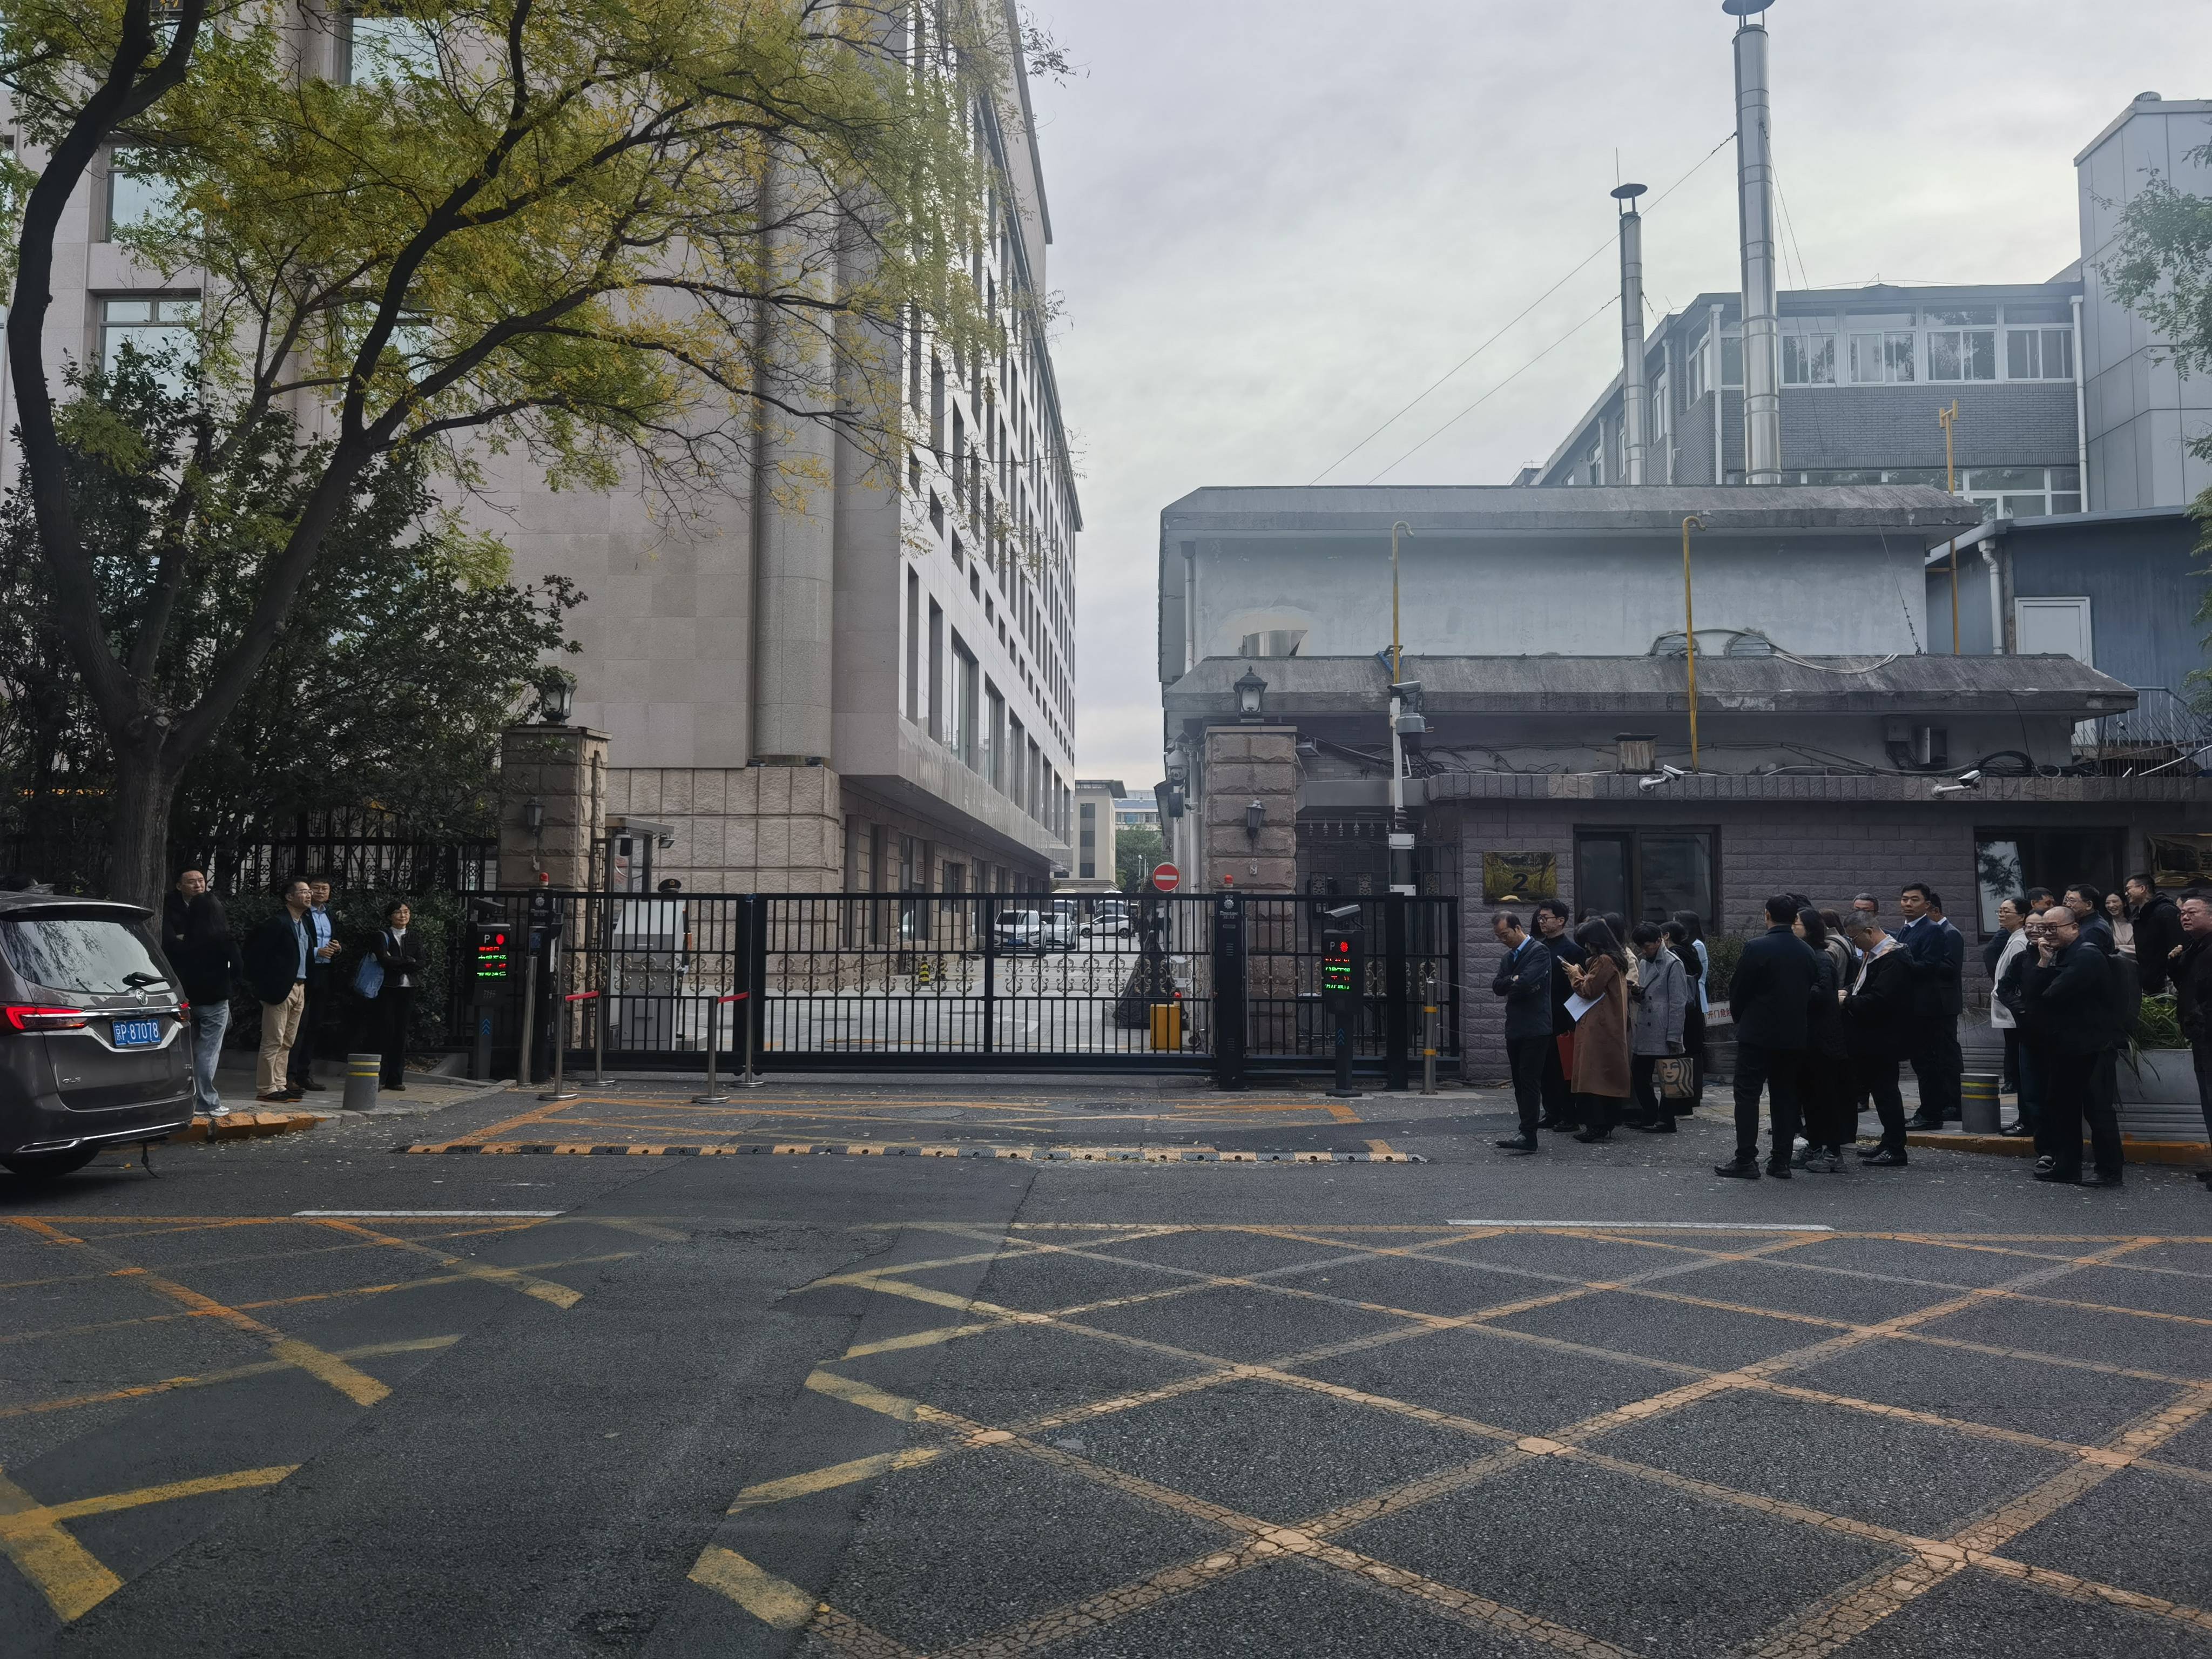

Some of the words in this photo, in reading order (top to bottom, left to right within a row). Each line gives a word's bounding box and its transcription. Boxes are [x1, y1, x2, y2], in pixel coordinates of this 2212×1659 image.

[1512, 872, 1529, 892] 2
[484, 934, 490, 943] P
[1330, 941, 1336, 950] P
